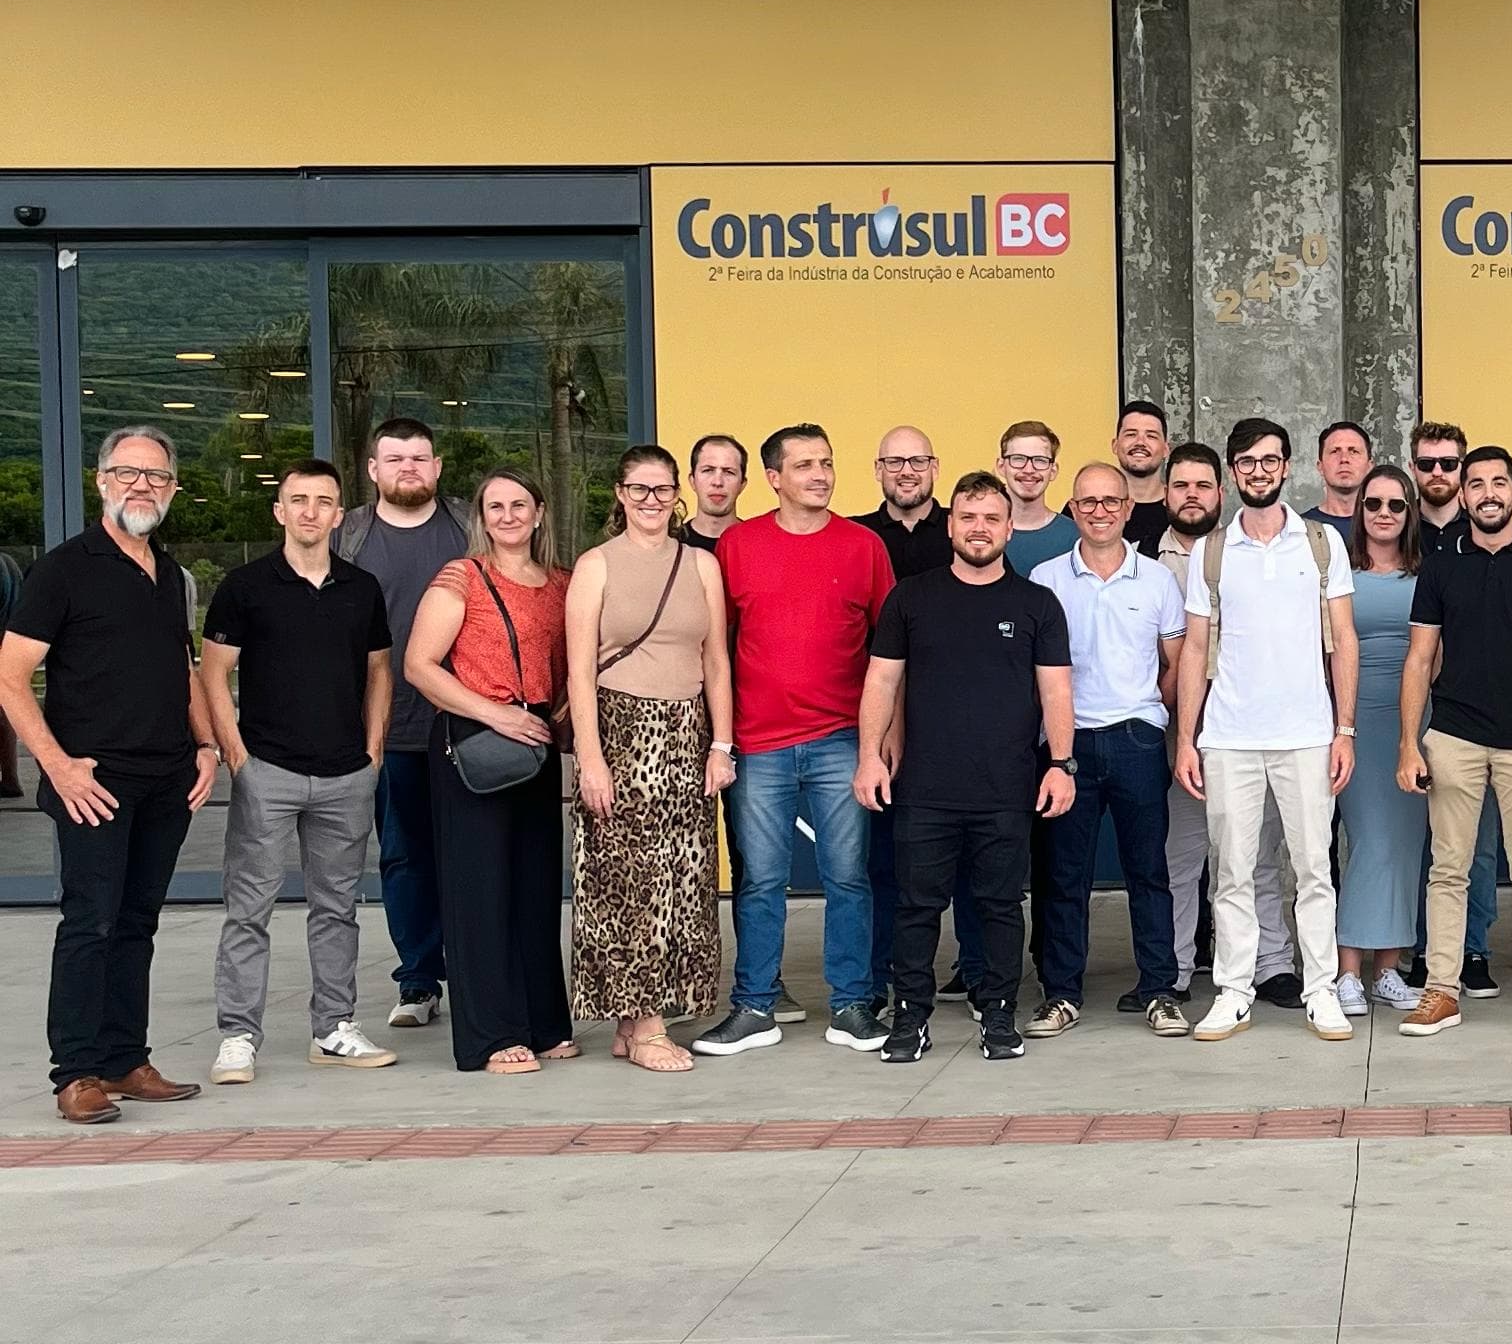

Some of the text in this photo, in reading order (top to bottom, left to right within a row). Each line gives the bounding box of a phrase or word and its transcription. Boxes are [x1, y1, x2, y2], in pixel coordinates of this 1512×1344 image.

[1000, 202, 1067, 249] BC
[727, 265, 763, 282] Feira
[766, 265, 785, 281] da
[788, 264, 848, 281] Indústria
[851, 264, 869, 280] da
[872, 263, 952, 283] Construção
[955, 267, 965, 280] e
[968, 262, 1055, 280] Acabamento
[1214, 233, 1329, 325] 2450
